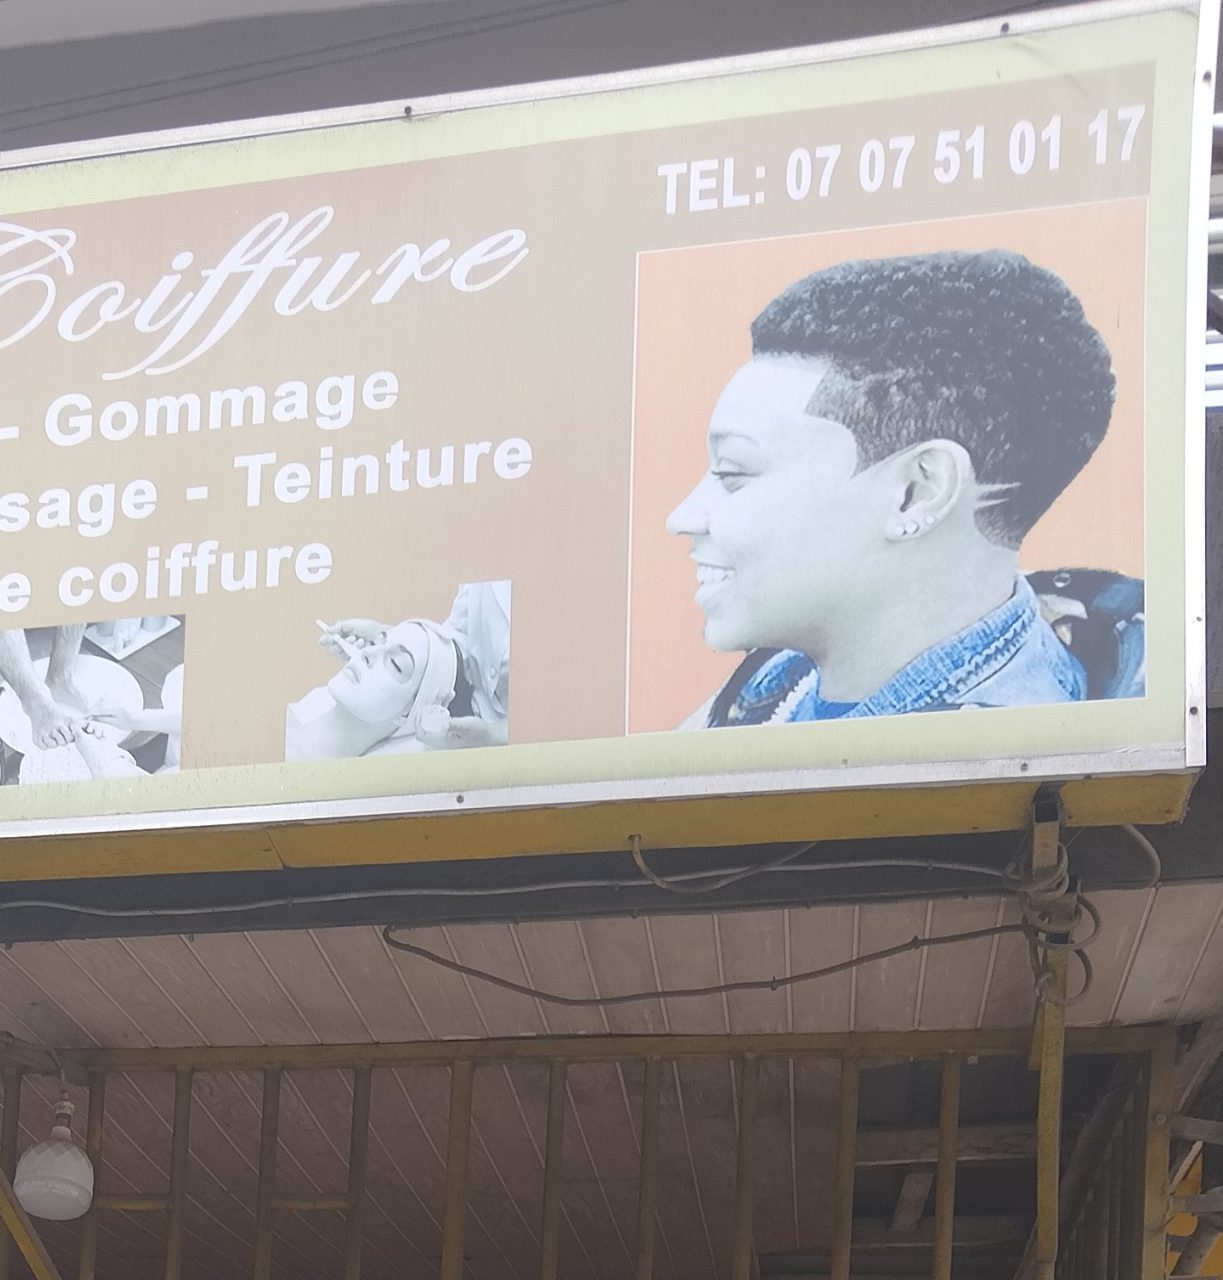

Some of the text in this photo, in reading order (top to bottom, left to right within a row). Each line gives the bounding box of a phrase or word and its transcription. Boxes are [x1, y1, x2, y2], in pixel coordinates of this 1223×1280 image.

[657, 104, 1146, 215] TEL: 07 07 51 01 17
[44, 369, 400, 447] Gommage
[233, 437, 533, 507] Teinture
[58, 539, 333, 607] coiffure
